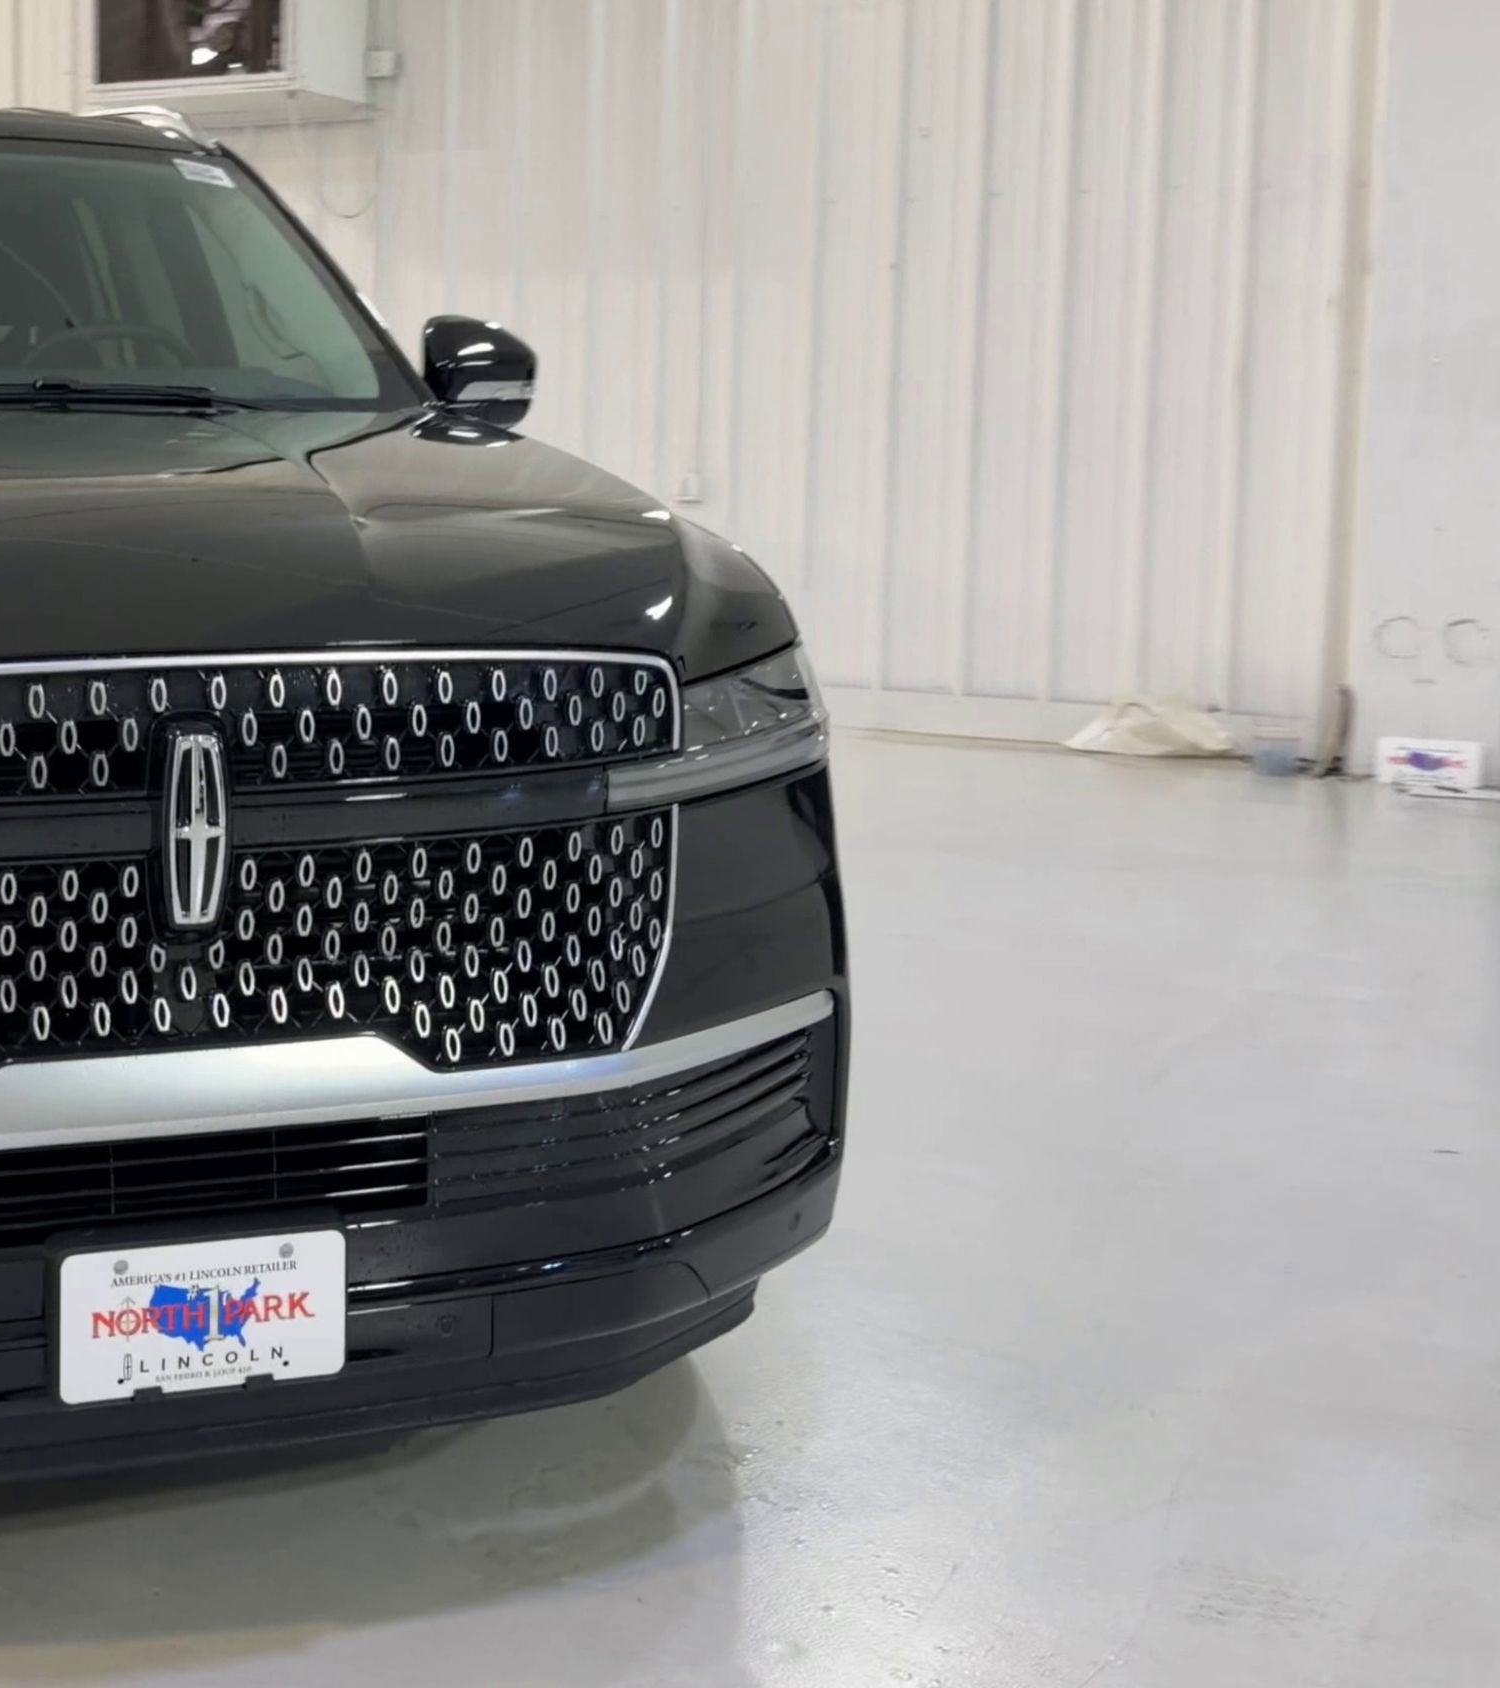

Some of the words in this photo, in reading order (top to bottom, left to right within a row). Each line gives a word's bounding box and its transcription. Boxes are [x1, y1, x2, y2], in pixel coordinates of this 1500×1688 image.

[111, 1273, 172, 1288] AMERICA'S
[175, 1272, 186, 1282] #1
[189, 1265, 242, 1281] LINCOLN
[244, 1260, 297, 1275] RETAILER
[91, 1301, 205, 1339] NORTH
[225, 1291, 315, 1325] PARK
[140, 1346, 283, 1374] LINCOLN
[156, 1374, 171, 1383] SAN
